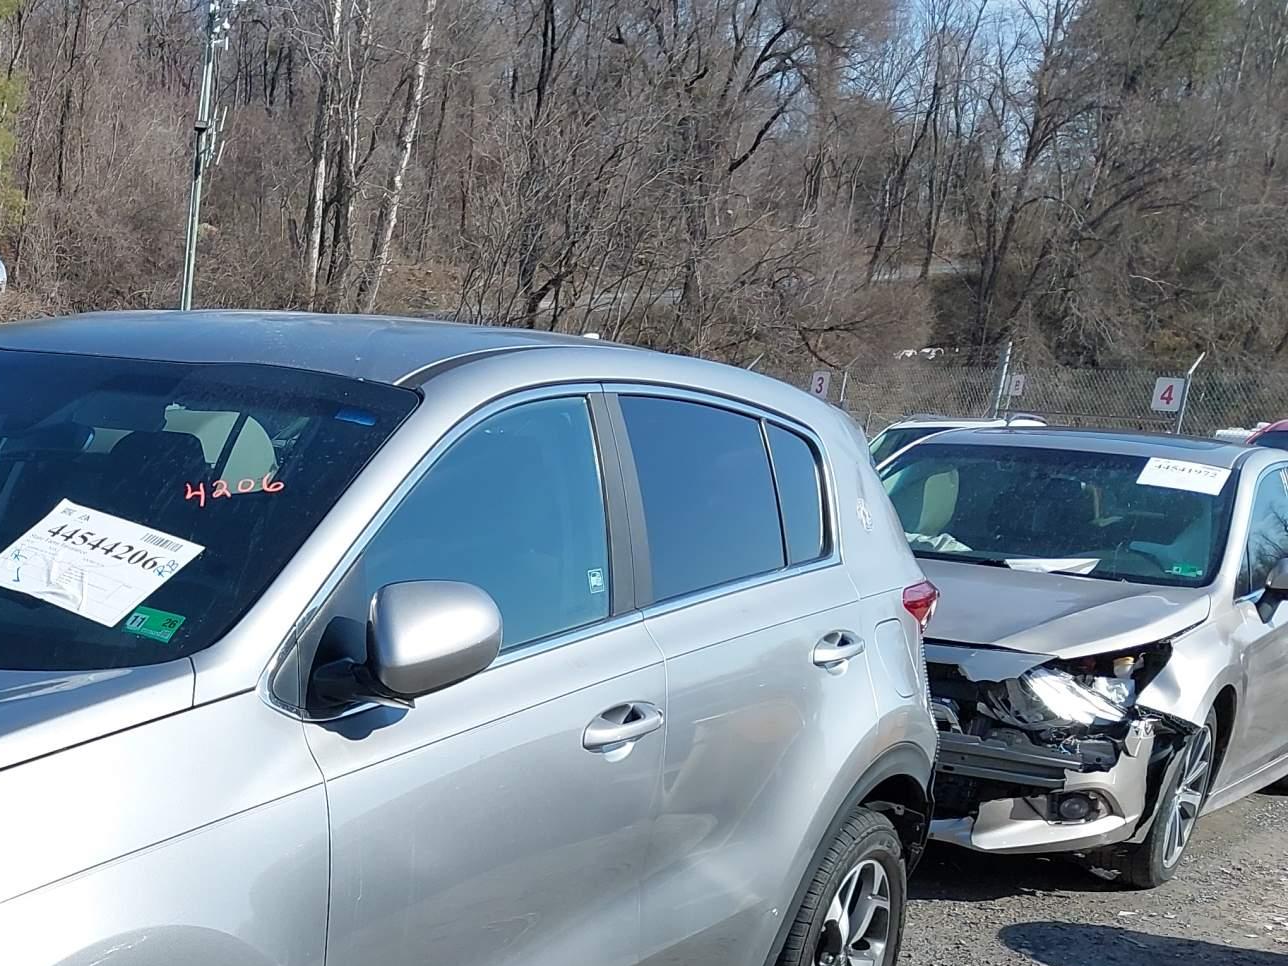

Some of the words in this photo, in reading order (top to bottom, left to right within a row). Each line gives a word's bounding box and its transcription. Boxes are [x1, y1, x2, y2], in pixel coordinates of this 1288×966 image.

[815, 376, 825, 394] 3
[1160, 384, 1173, 405] 4
[185, 473, 285, 508] 4206
[47, 523, 164, 571] 44544206
[129, 615, 146, 628] 11
[162, 618, 179, 629] 26
